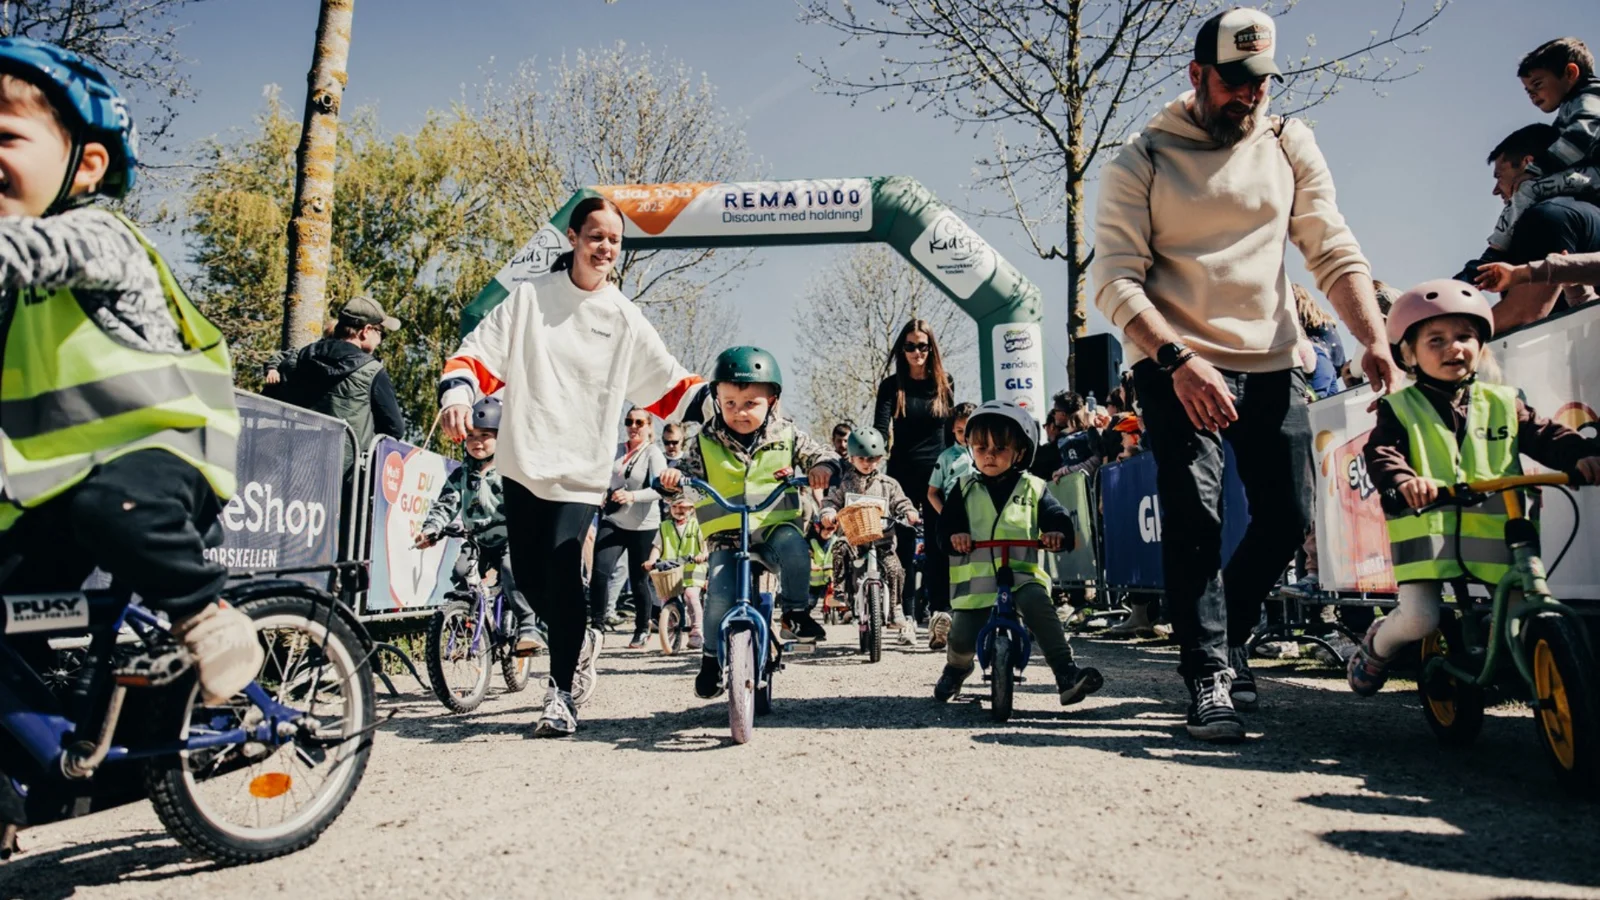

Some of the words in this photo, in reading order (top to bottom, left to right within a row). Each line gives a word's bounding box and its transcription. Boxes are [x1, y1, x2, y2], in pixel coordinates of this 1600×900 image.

[637, 201, 665, 213] 2025
[724, 191, 797, 208] REMA
[806, 189, 861, 206] 1000
[722, 211, 777, 224] Discount
[779, 210, 806, 222] med
[809, 208, 864, 223] holdning!
[1005, 378, 1033, 390] GLS
[417, 472, 435, 492] DU
[401, 493, 431, 515] GJOR
[217, 481, 326, 548] eShop
[13, 597, 80, 614] PUKY
